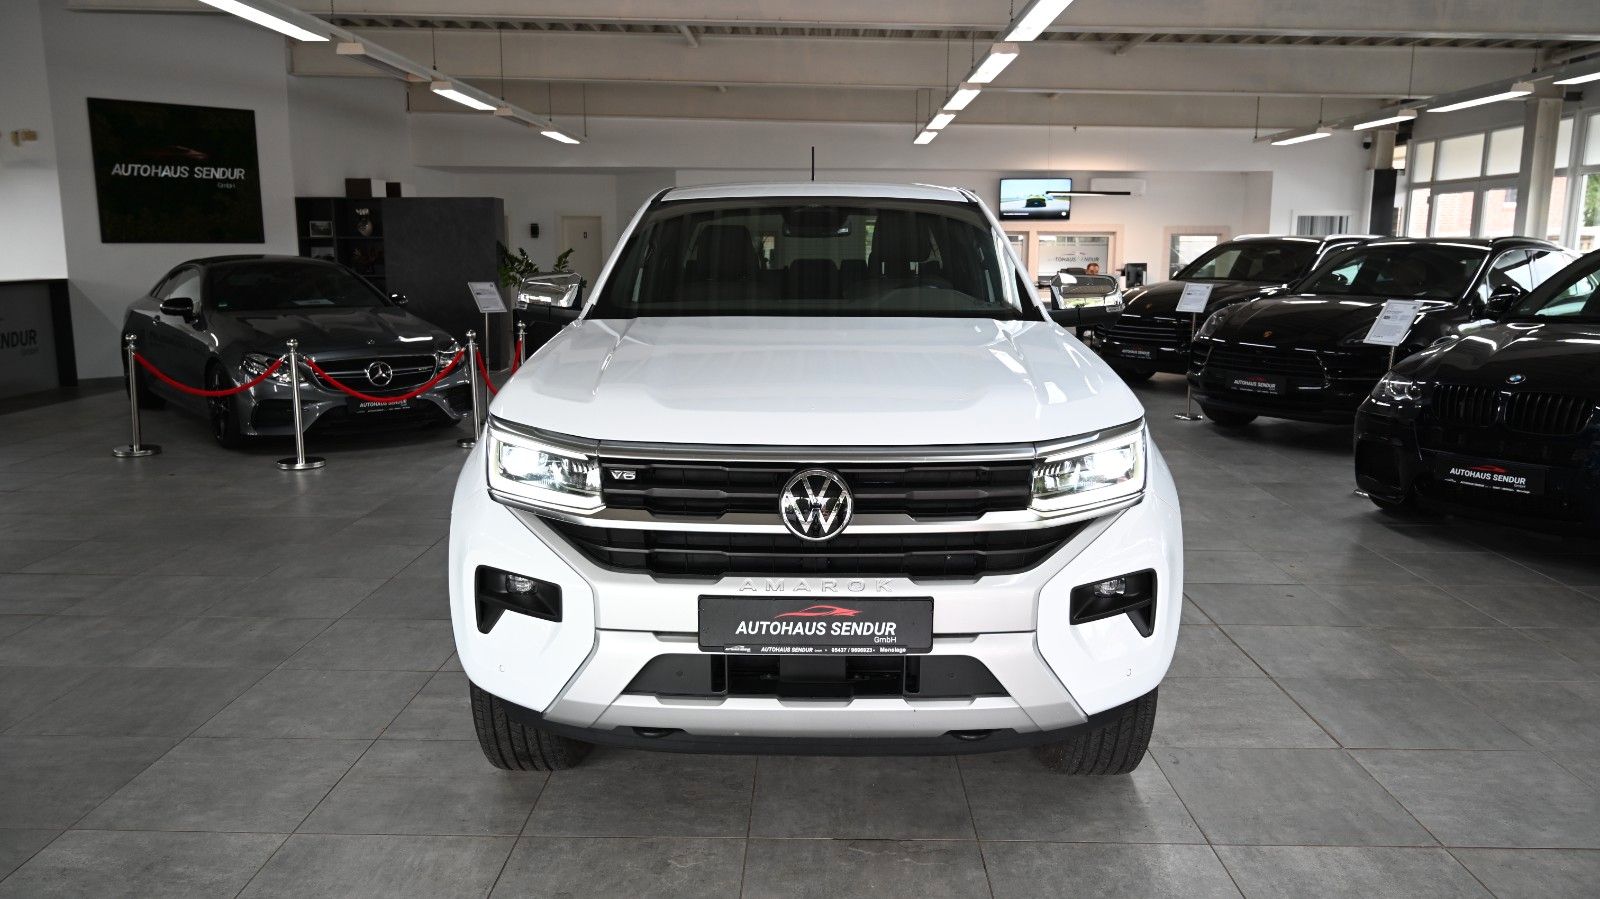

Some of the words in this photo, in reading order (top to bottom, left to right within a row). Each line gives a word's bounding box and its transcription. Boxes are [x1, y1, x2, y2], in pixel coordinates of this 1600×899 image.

[112, 163, 189, 178] AUTOHAUS
[194, 166, 245, 180] SENDUR
[611, 470, 636, 480] V6
[1449, 467, 1491, 480] AUTOHAUS
[1493, 474, 1526, 485] SENDUR
[738, 578, 896, 592] AMAROK
[735, 621, 827, 636] AUTOHAUS
[830, 621, 897, 636] SENDUR
[873, 636, 897, 644] GmbH
